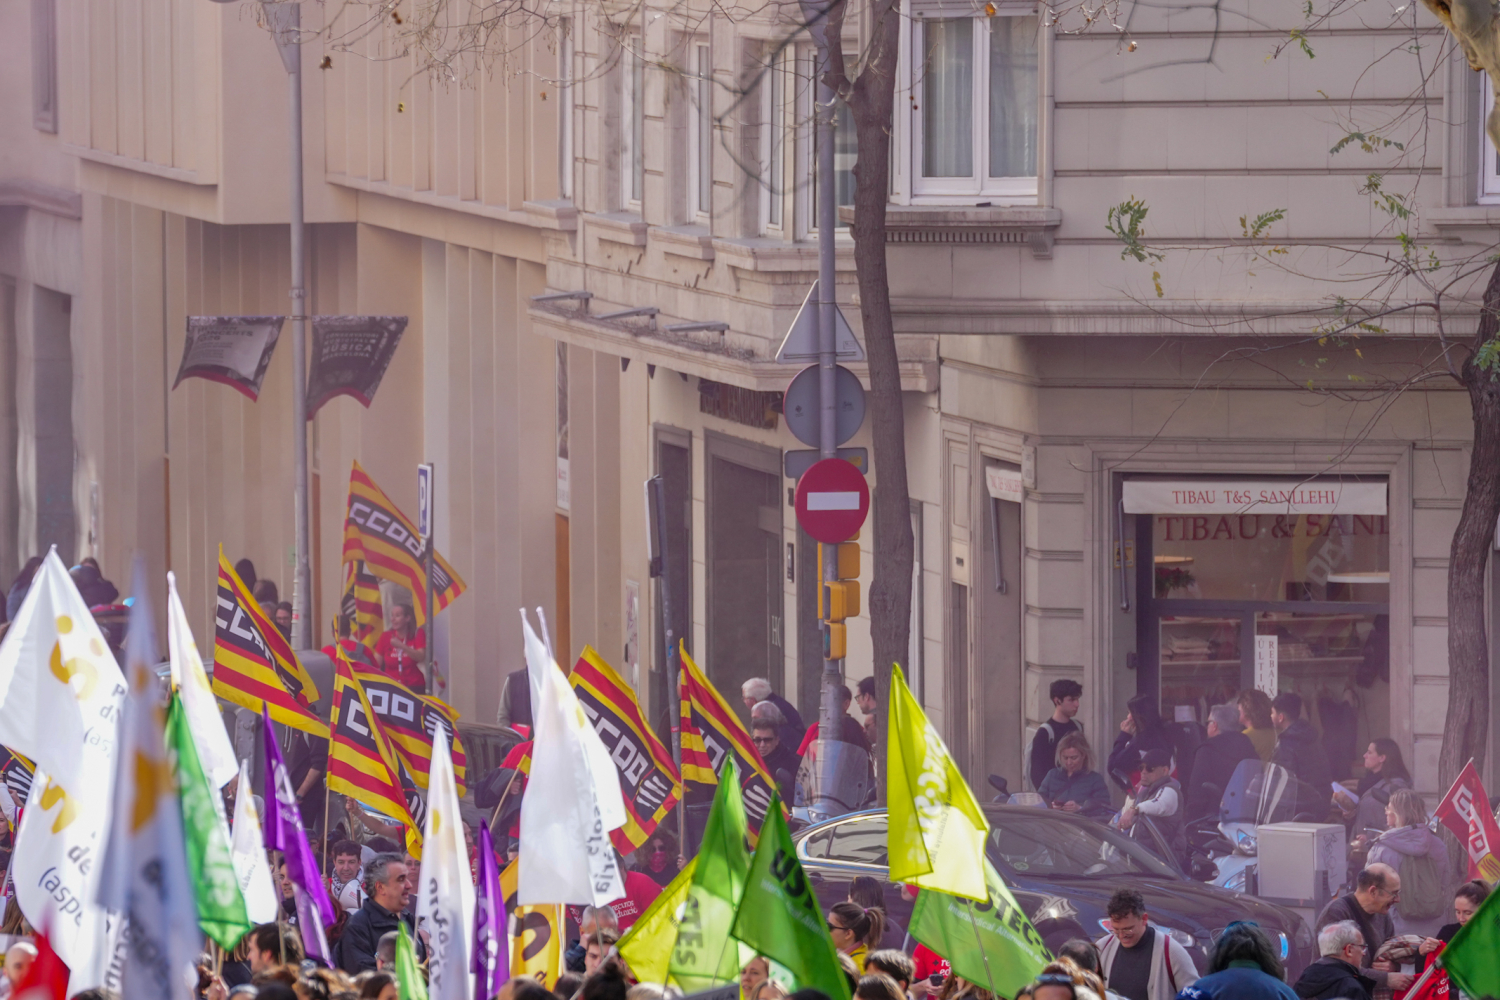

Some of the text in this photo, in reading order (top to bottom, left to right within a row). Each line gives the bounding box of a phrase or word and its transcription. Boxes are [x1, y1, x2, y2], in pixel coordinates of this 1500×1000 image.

[1171, 490, 1336, 505] TIBAU T&S SANLLEHI
[350, 501, 423, 558] CCOO
[1158, 514, 1261, 541] TIBAU
[1180, 986, 1203, 1000] NY
